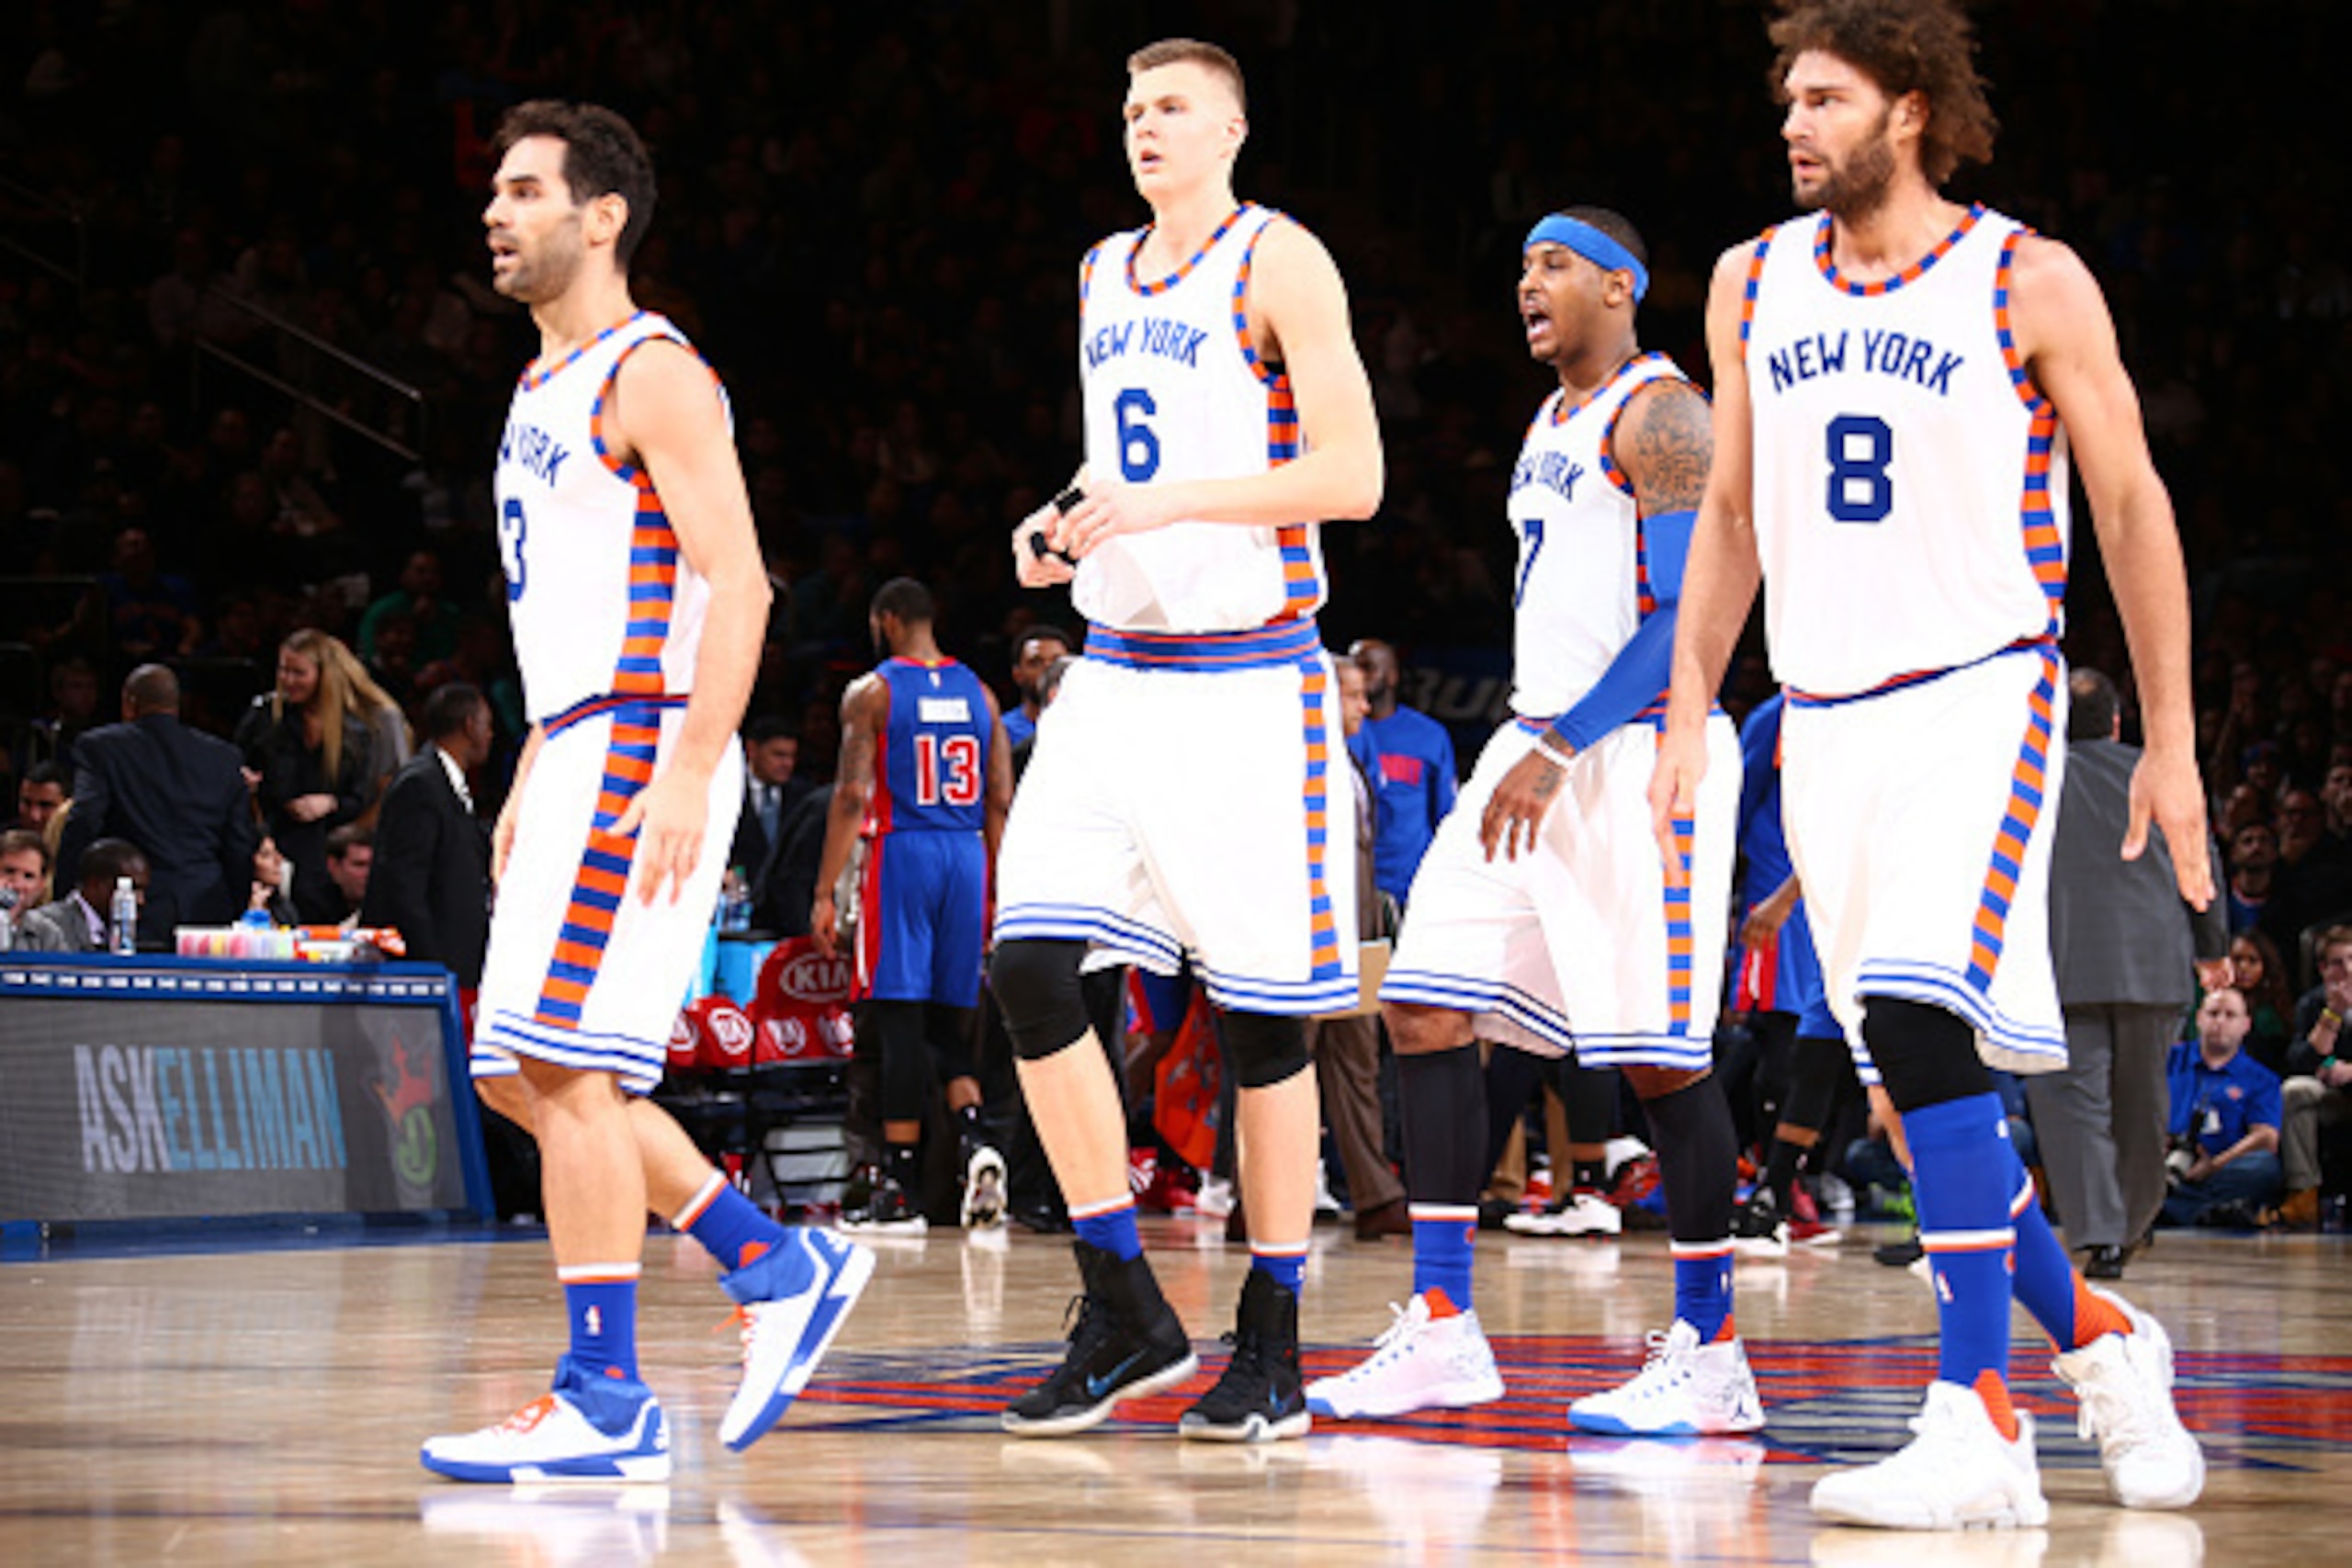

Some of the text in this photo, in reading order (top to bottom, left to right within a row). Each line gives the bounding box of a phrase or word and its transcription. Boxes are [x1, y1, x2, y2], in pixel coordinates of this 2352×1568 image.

[1139, 315, 1210, 369] YORK
[1768, 327, 1964, 397] NEW YORK
[1113, 388, 1160, 483] 6
[1826, 412, 1894, 523] 8
[503, 498, 527, 602] 3
[1514, 518, 1544, 610] 7
[913, 734, 982, 807] 13
